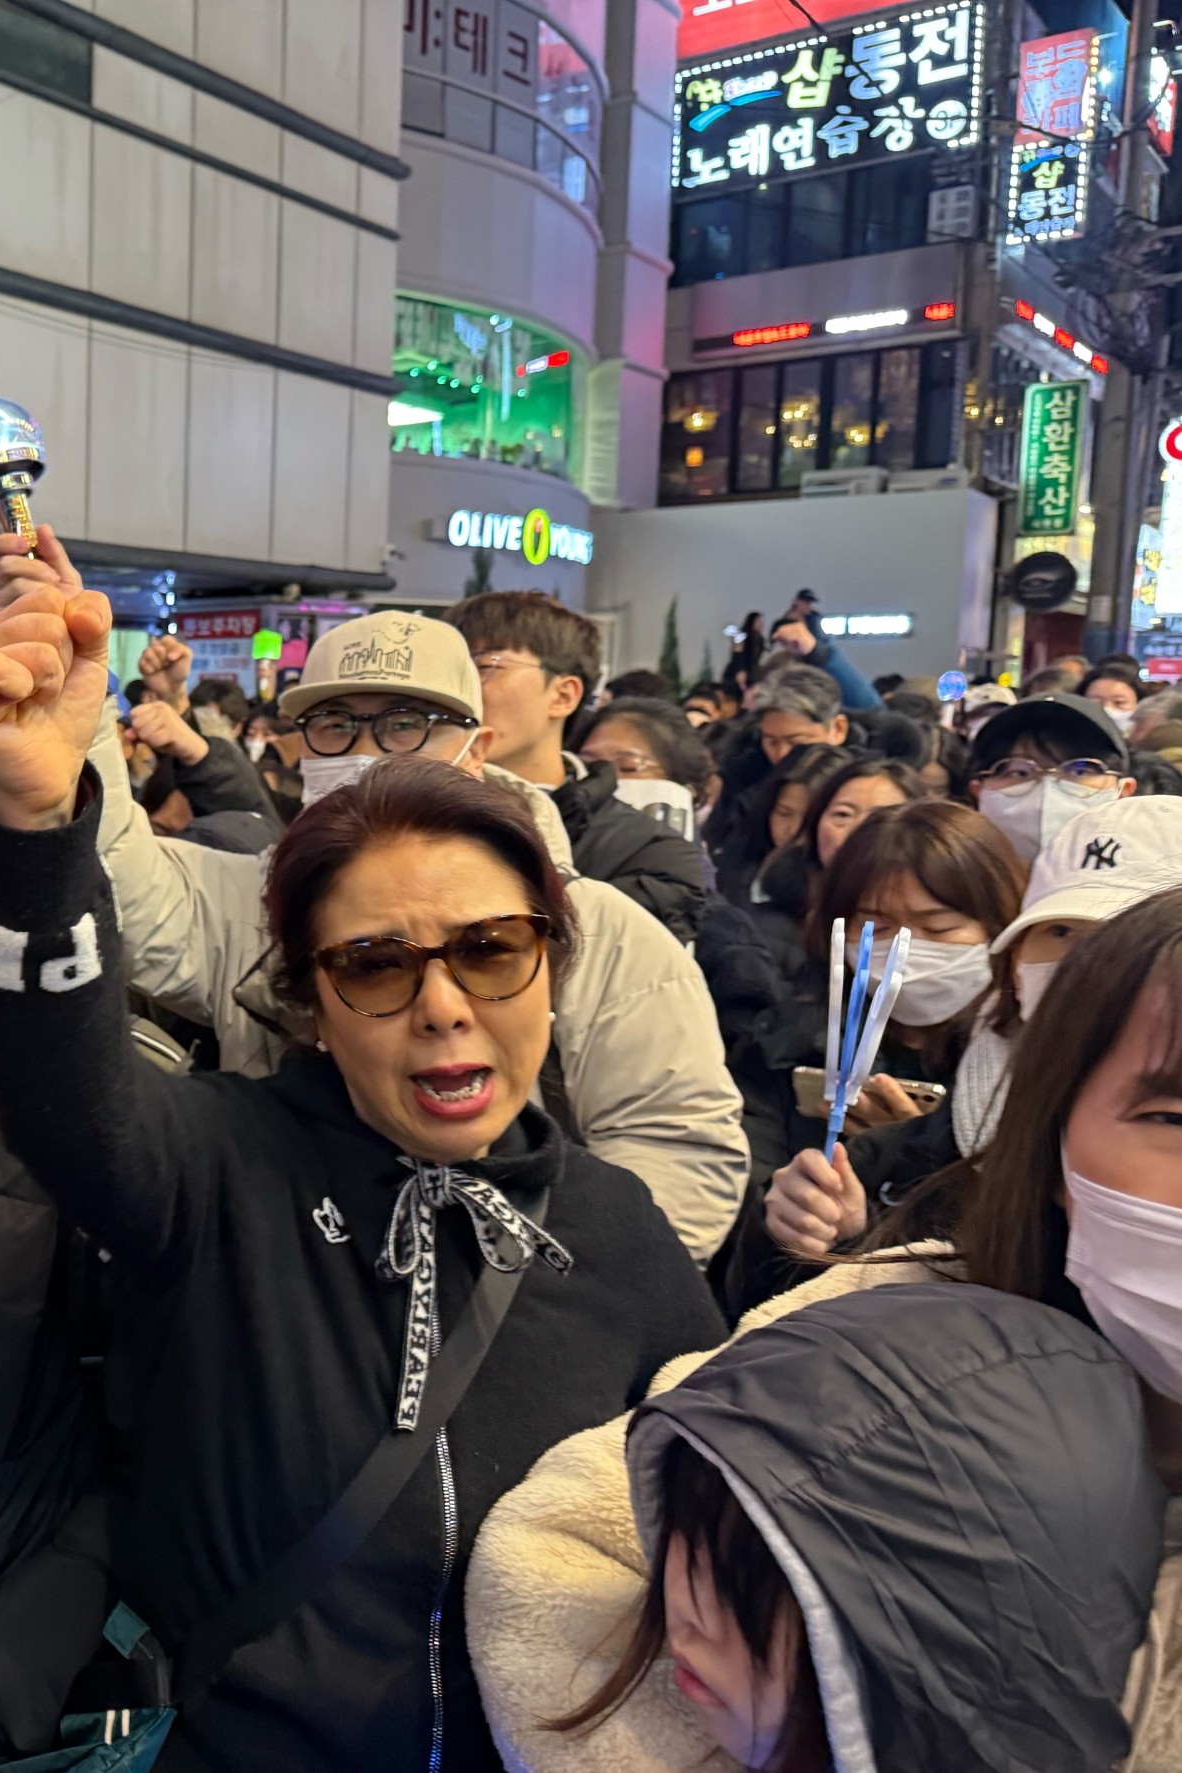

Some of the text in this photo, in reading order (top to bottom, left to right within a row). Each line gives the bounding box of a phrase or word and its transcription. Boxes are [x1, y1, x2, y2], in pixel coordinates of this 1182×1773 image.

[682, 97, 926, 188] 노래연습장
[448, 509, 523, 551] OLIVE
[1081, 837, 1122, 870] NY
